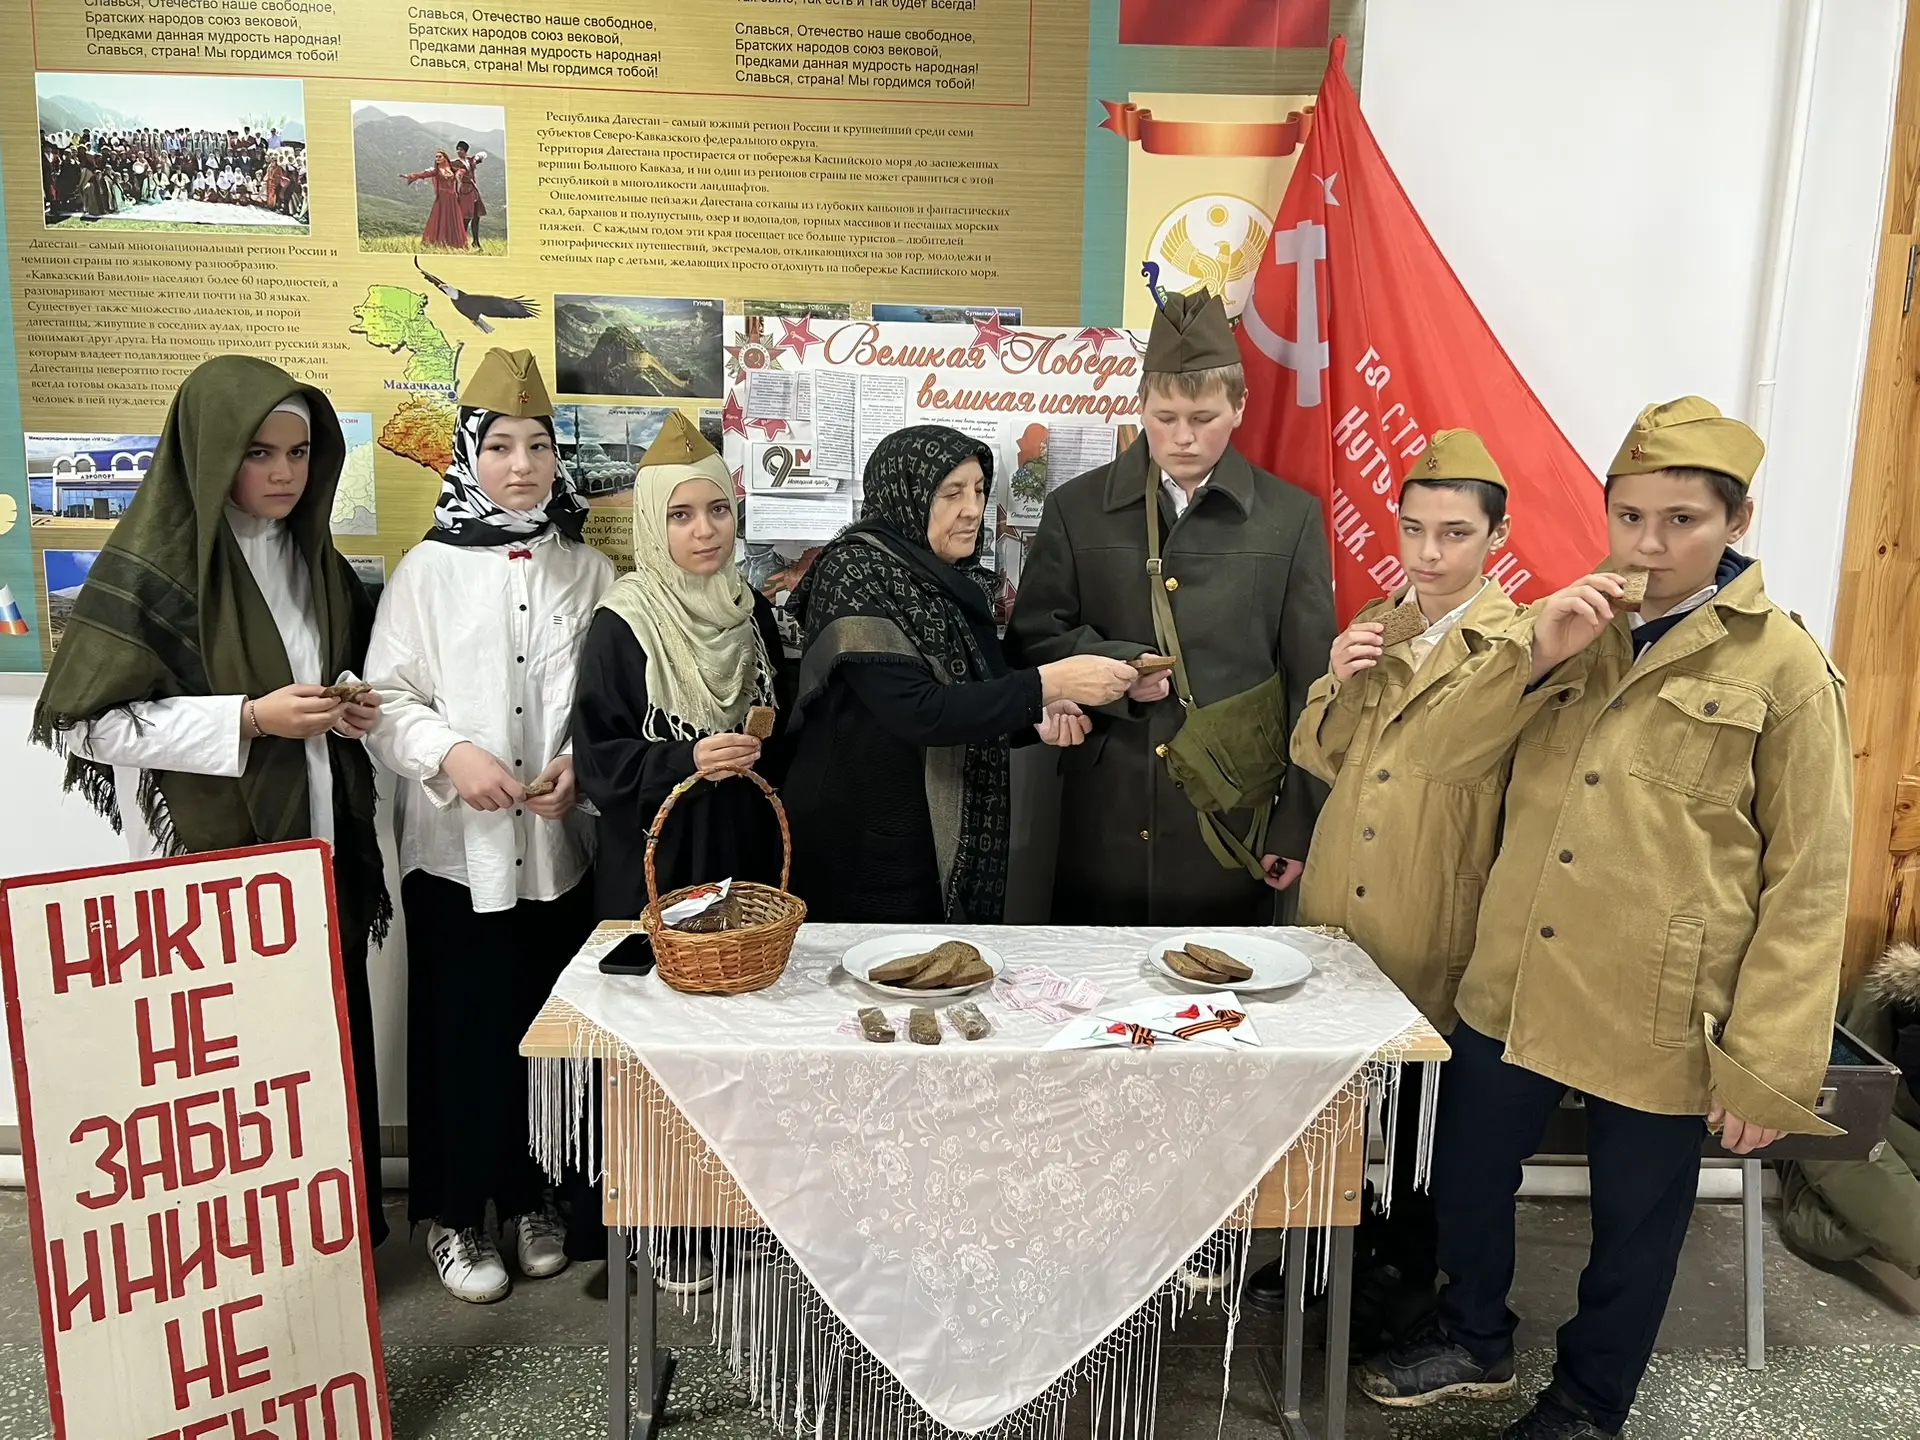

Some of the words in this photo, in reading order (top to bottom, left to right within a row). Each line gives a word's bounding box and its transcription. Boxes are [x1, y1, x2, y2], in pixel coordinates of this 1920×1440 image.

[222, 0, 258, 11] наше
[261, 0, 336, 14] свободное,
[931, 0, 976, 11] всегда!
[84, 10, 145, 26] Братских
[147, 14, 204, 27] народов
[207, 16, 241, 27] союз
[243, 15, 301, 30] вековой,
[407, 6, 468, 23] Славься,
[471, 9, 541, 25] Отечество
[544, 15, 580, 26] наше
[583, 15, 656, 31] свободное,
[85, 27, 152, 42] Предками
[155, 31, 204, 43] данная
[207, 32, 270, 45] мудрость
[273, 33, 341, 47] народная!
[408, 22, 468, 37] Братских
[471, 27, 527, 41] народов
[530, 30, 563, 41] союз
[566, 31, 622, 46] вековой,
[734, 22, 793, 38] Славься,
[796, 24, 864, 38] Отечество
[867, 29, 901, 39] наше
[904, 28, 975, 43] свободное,
[86, 43, 147, 58] Славься,
[150, 45, 200, 60] страна!
[203, 46, 226, 59] Мы
[229, 49, 292, 62] гордимся
[295, 48, 338, 61] тобой!
[408, 38, 476, 54] Предками
[478, 44, 527, 56] данная
[530, 46, 591, 60] мудрость
[595, 49, 662, 63] народная!
[735, 38, 793, 54] Братских
[796, 43, 849, 56] народов
[852, 44, 884, 55] союз
[887, 44, 942, 59] вековой,
[409, 54, 469, 71] Славься,
[473, 59, 522, 73] страна!
[526, 60, 549, 73] Мы
[552, 63, 613, 77] гордимся
[616, 64, 658, 78] тобой!
[735, 54, 799, 69] Предками
[802, 58, 848, 70] данная
[852, 60, 912, 73] мудрость
[914, 61, 978, 75] народная!
[734, 70, 793, 85] Славься,
[796, 73, 844, 87] страна!
[847, 73, 869, 86] Мы
[872, 76, 931, 89] гордимся
[934, 76, 975, 89] тобой!
[824, 322, 986, 368] Великая
[1000, 332, 1137, 390] Победа
[383, 379, 451, 391] Махачкала
[916, 373, 1036, 411] великая
[1038, 391, 1142, 423] истори
[593, 516, 633, 524] располо
[580, 526, 602, 534] одок
[604, 526, 633, 536] Избер
[45, 872, 297, 995] НИКТО
[135, 982, 240, 1087] НЕ
[69, 1070, 312, 1211] ЗАБЫТ
[164, 1294, 271, 1411] НЕ
